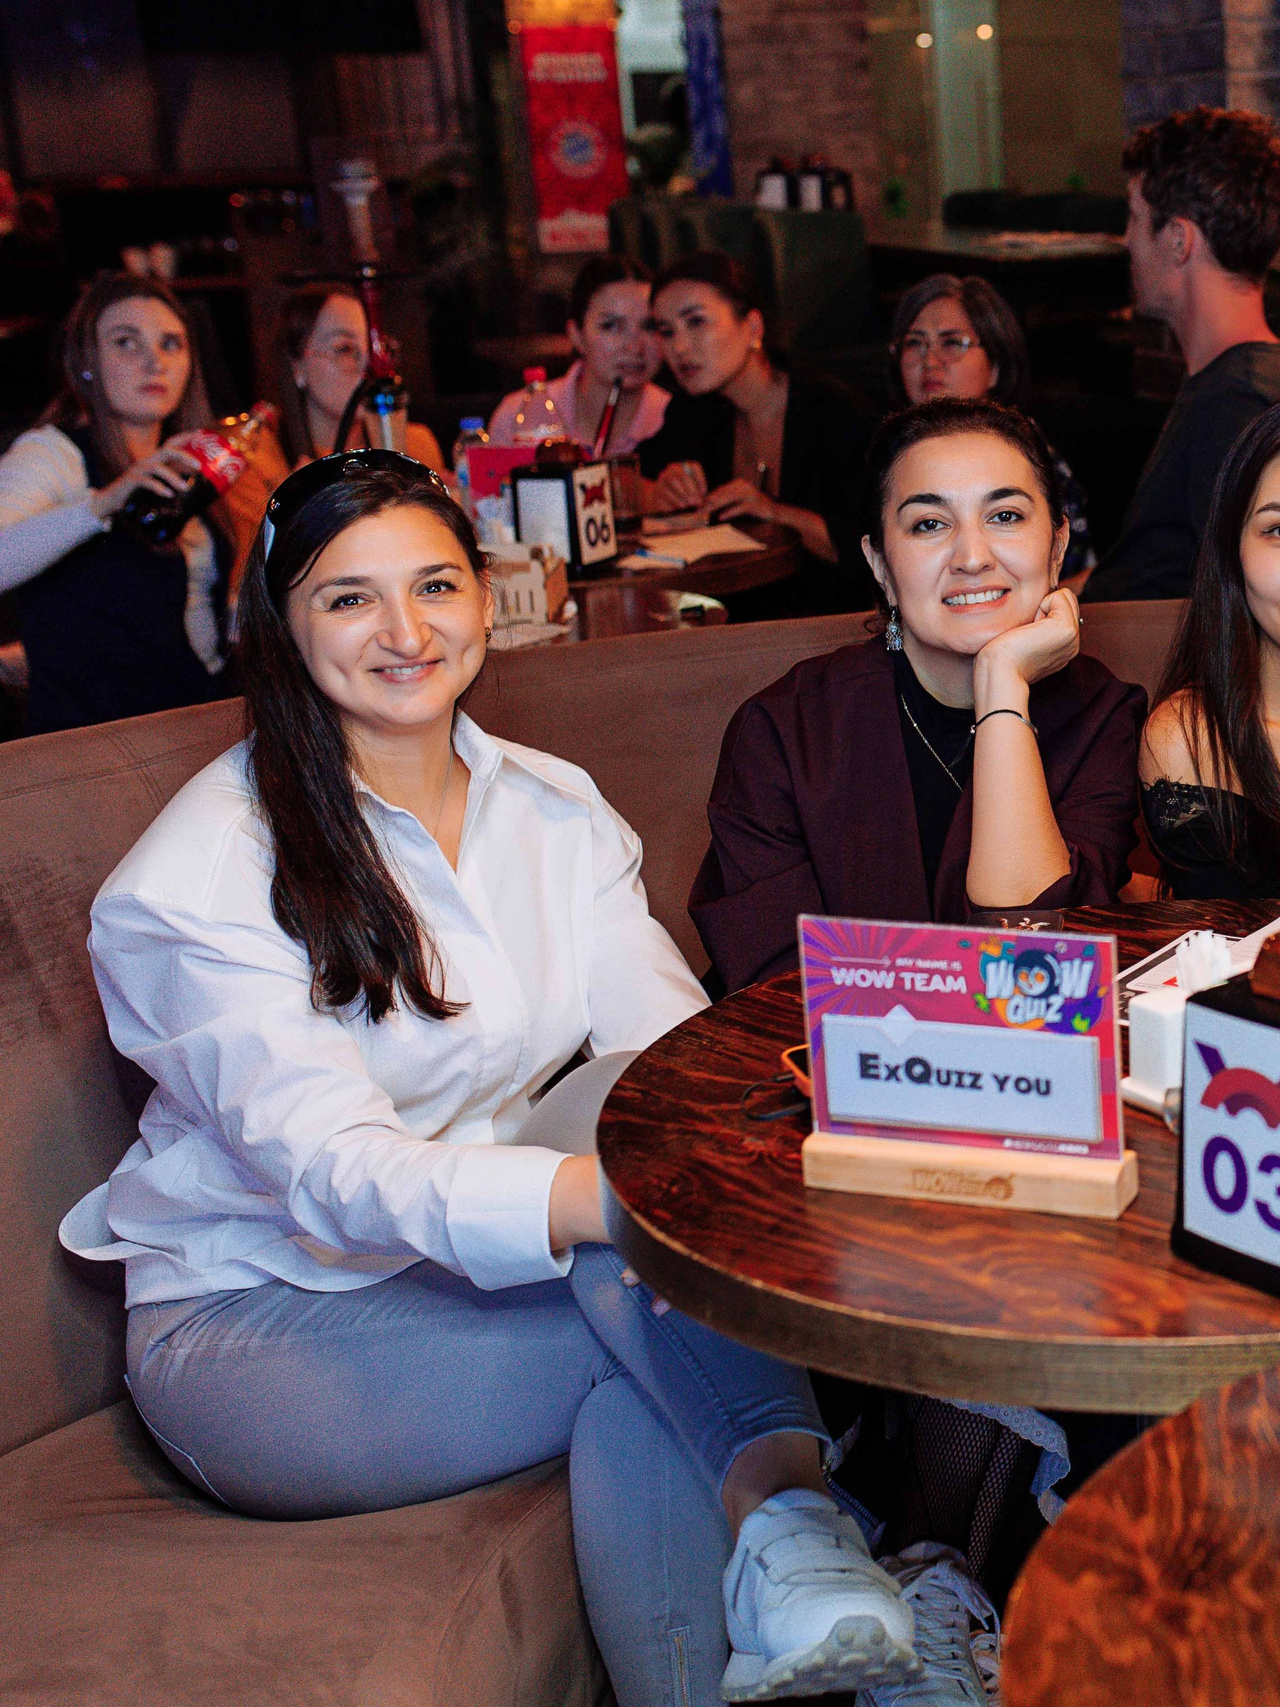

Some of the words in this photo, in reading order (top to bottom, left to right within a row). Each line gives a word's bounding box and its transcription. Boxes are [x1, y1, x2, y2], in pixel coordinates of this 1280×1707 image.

[585, 516, 611, 547] 06
[915, 958, 949, 971] NAME
[985, 950, 1095, 999] WOW
[830, 967, 896, 989] WOW
[899, 971, 967, 994] TEAM
[1006, 993, 1066, 1024] QUIZ
